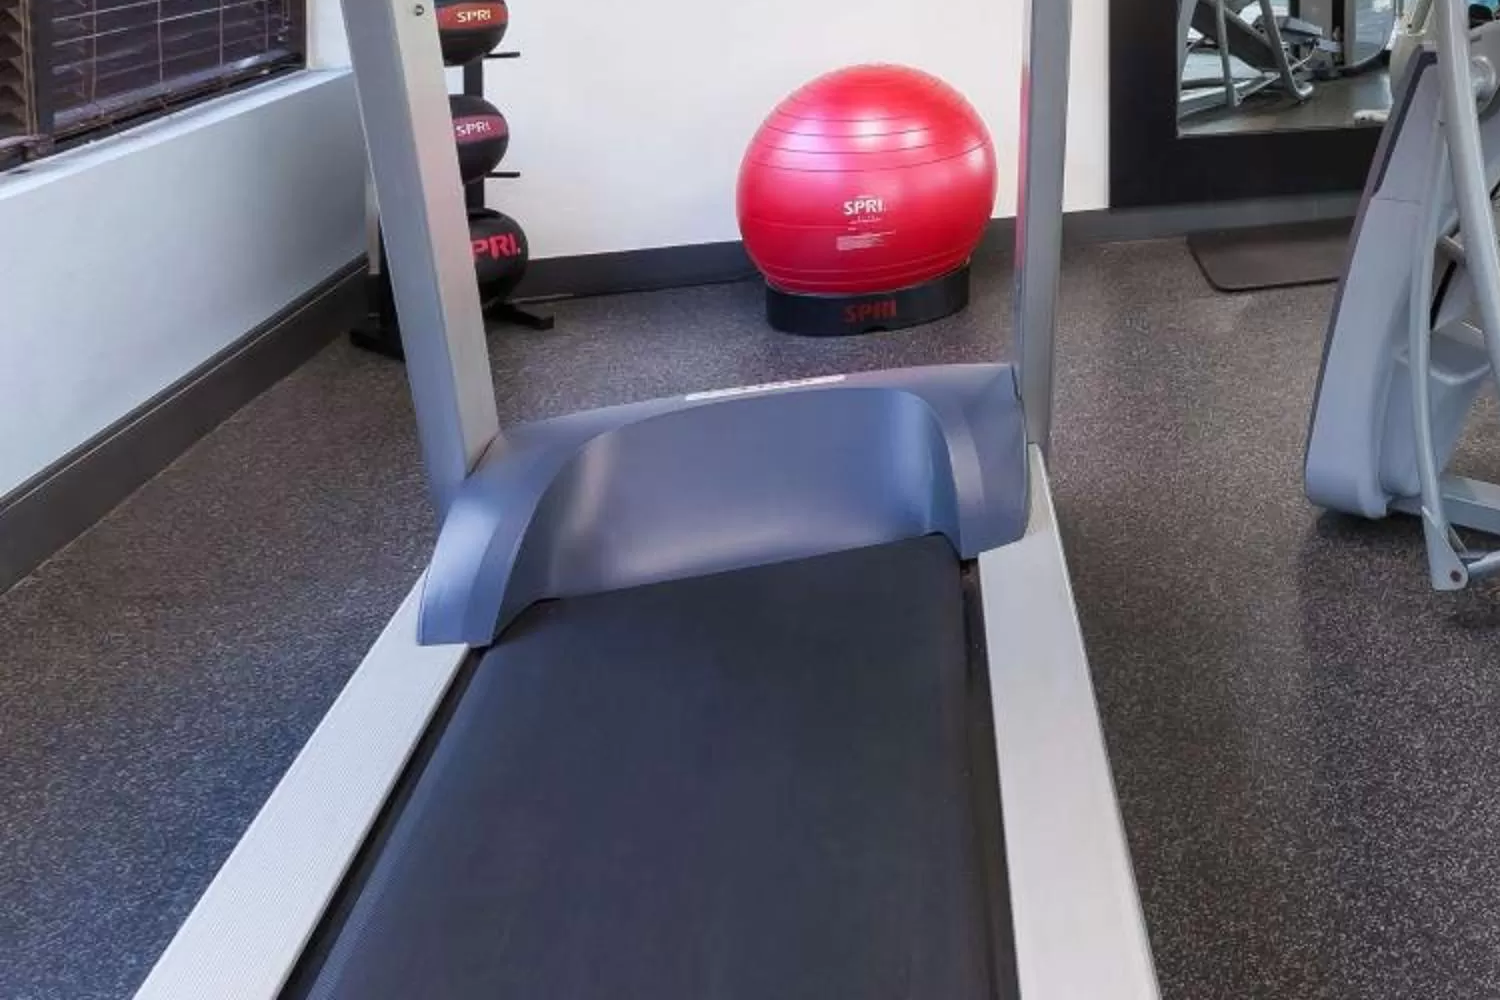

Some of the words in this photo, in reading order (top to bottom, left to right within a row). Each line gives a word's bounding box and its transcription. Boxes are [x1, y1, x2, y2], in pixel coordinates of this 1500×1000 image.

[456, 9, 491, 23] SPRI
[455, 120, 492, 137] SPRI
[843, 198, 883, 216] SPRI
